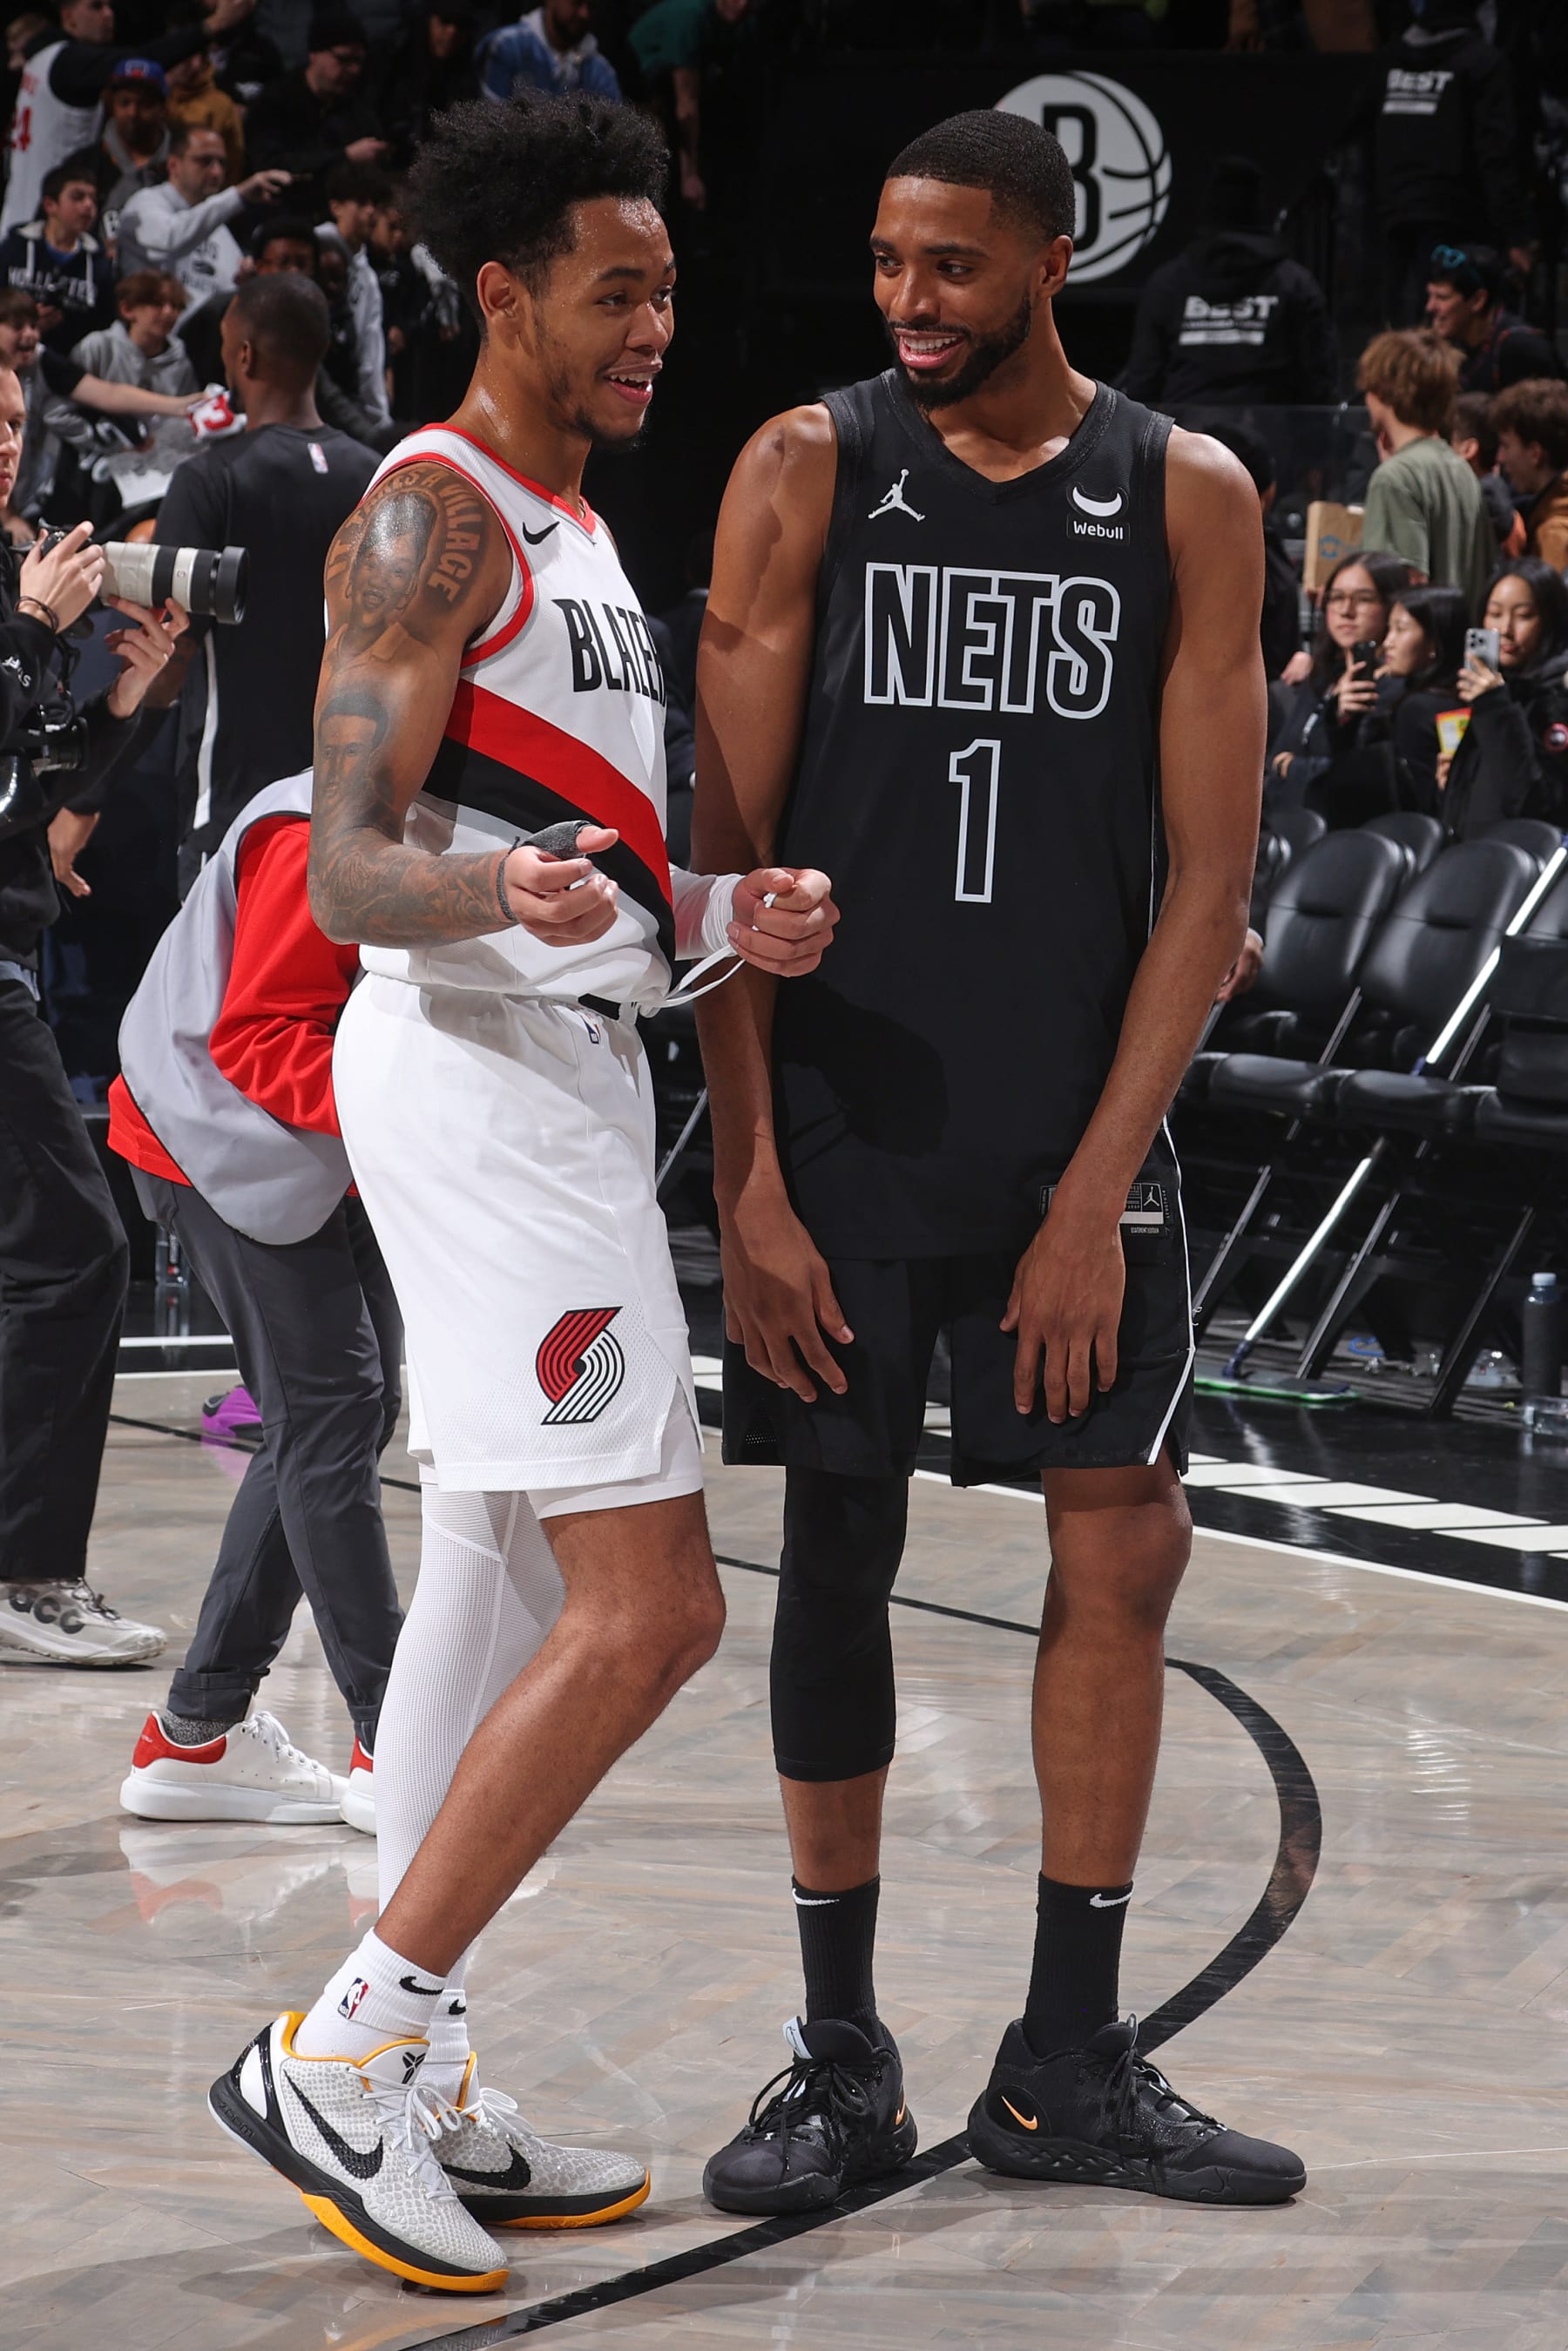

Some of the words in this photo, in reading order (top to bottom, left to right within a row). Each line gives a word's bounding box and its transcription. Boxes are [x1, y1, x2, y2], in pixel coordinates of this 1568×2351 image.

[427, 483, 483, 603] VILLAGE
[1073, 520, 1124, 540] Webull
[864, 562, 1121, 719] NETS
[948, 738, 1002, 903] 1
